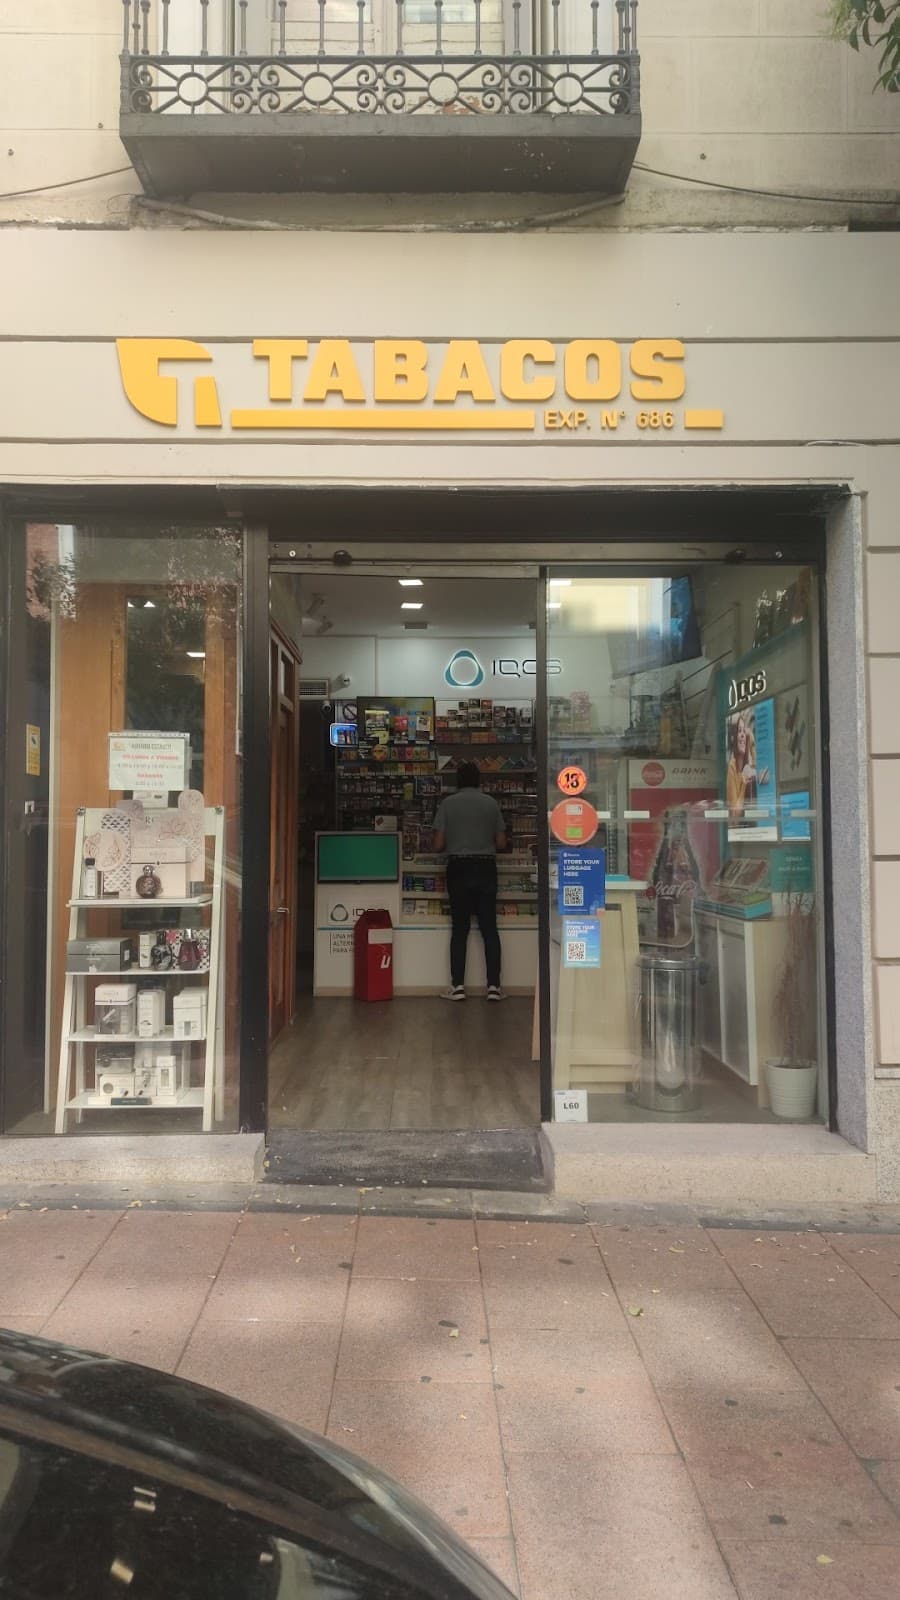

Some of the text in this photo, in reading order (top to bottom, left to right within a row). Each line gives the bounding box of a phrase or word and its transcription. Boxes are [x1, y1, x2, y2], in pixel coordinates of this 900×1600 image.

[253, 339, 686, 402] TABACOS
[543, 410, 591, 430] EXP.
[637, 411, 674, 430] 686
[492, 659, 562, 678] IQOS
[563, 1102, 580, 1110] L60
